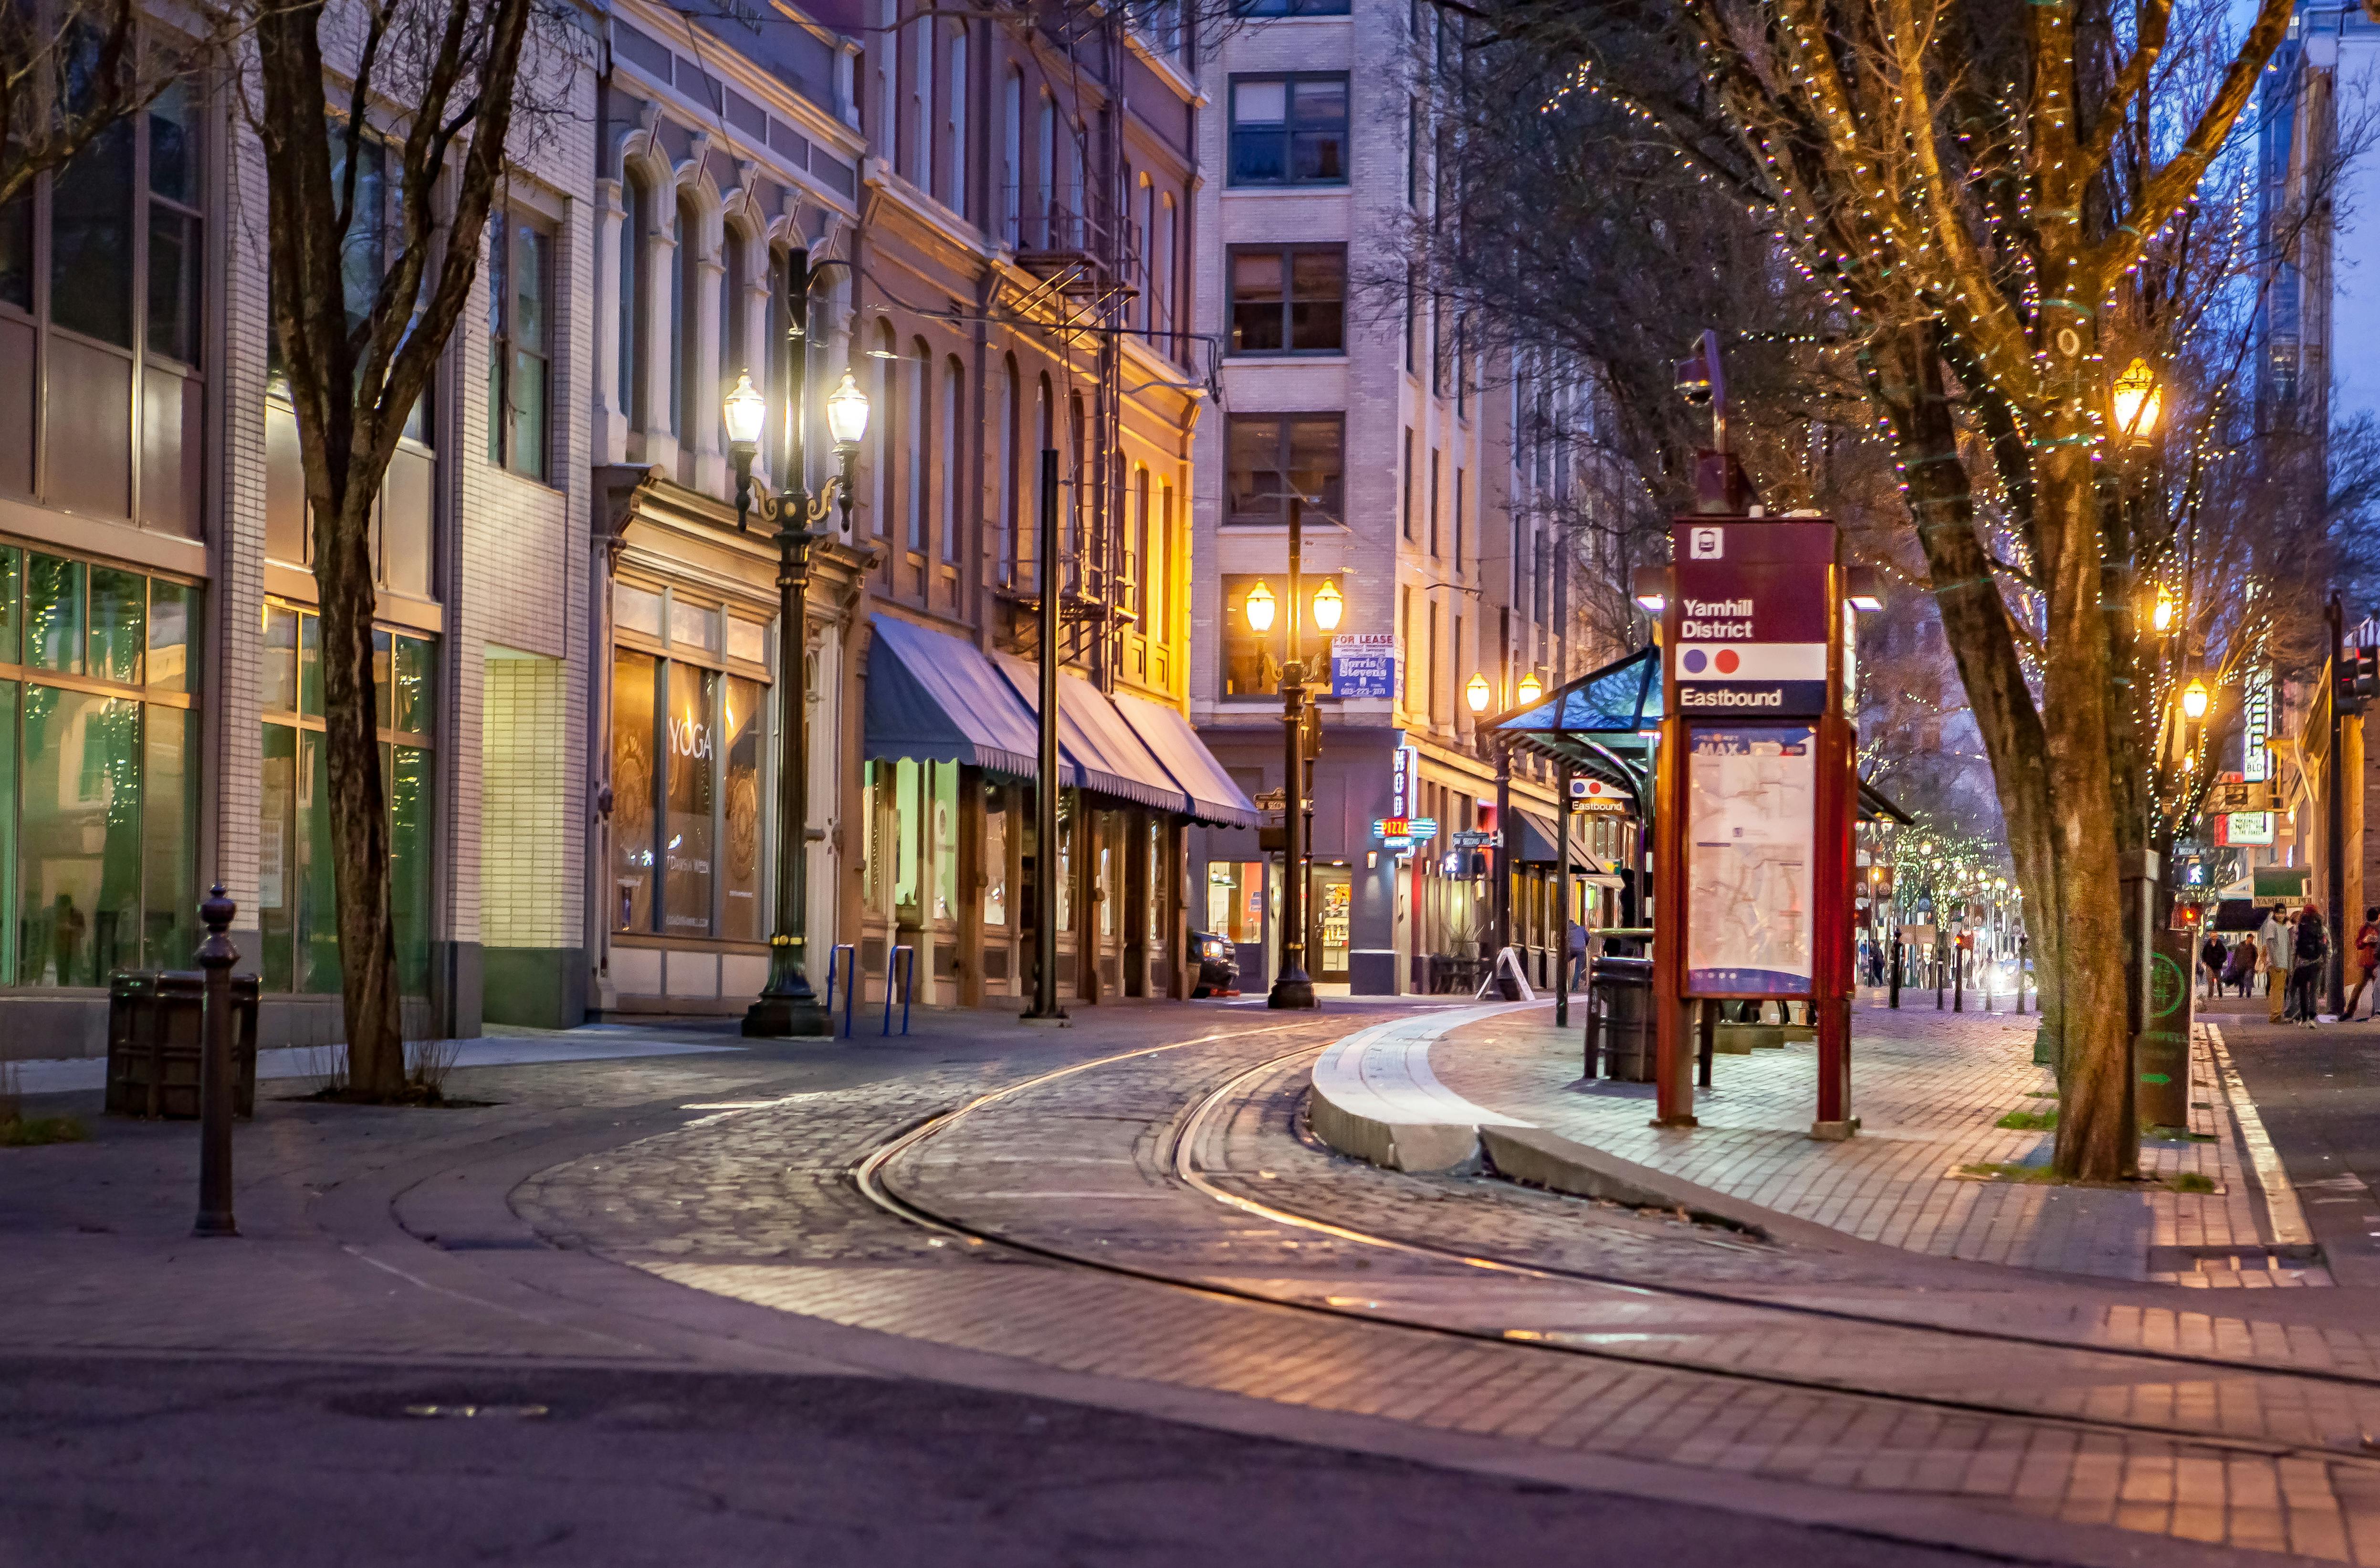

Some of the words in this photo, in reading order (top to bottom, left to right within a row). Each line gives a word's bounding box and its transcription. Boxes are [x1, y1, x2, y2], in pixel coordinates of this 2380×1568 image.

[1684, 599, 1753, 617] Yamhill
[1682, 621, 1753, 638] District
[1334, 635, 1354, 644] FOR
[1360, 635, 1393, 644] LEASE
[1680, 688, 1782, 706] Eastbound
[669, 716, 713, 761] YOGA
[1572, 800, 1623, 811] Eastbound
[1382, 821, 1408, 835] PIZZA
